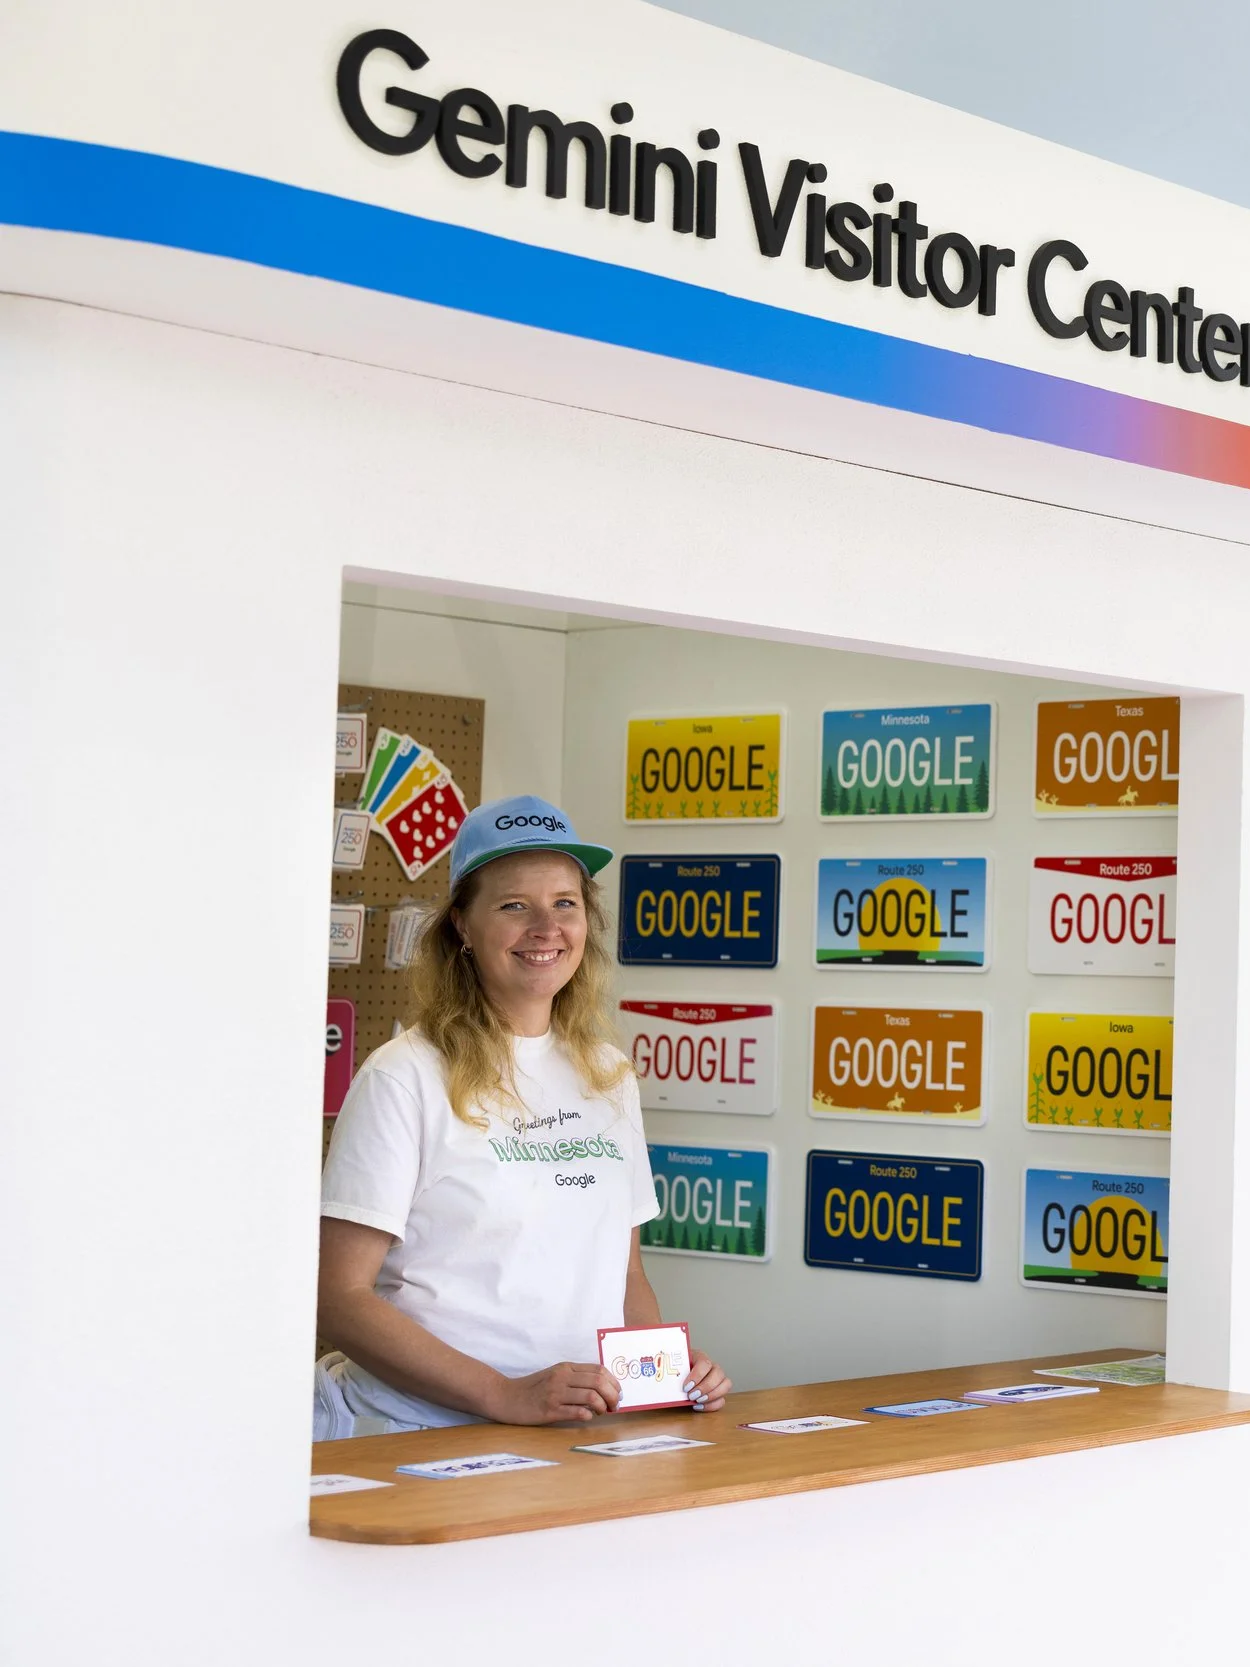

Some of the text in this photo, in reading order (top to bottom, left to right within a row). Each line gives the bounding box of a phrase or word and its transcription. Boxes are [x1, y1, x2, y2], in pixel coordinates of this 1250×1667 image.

[336, 28, 720, 240] Gemini
[738, 141, 1015, 316] Visitor
[881, 714, 930, 727] Minnesota
[1115, 705, 1144, 717] Texas
[692, 723, 713, 735] Iowa
[640, 744, 766, 794] GOOGLE
[837, 735, 975, 789] GOOGLE
[1053, 729, 1180, 784] GOOGL
[495, 815, 567, 833] Google
[677, 865, 720, 877] Route 250
[878, 864, 924, 876] Route 250
[1100, 863, 1152, 875] Route 250
[636, 890, 762, 938] GOOGLE
[833, 888, 970, 938] GOOGLE
[1050, 892, 1176, 945] GOOGL
[672, 1007, 716, 1020] Route 250
[884, 1014, 910, 1027] Texas
[1109, 1021, 1134, 1034] Iowa
[632, 1033, 757, 1085] GOOGLE
[828, 1036, 967, 1092] GOOGLE
[1046, 1045, 1172, 1101] GOOGL
[512, 1108, 581, 1134] Greetings from
[488, 1133, 624, 1162] Minnesota
[667, 1151, 713, 1166] Minnesota
[554, 1173, 596, 1189] Google
[870, 1165, 917, 1179] Route 250
[1092, 1180, 1144, 1194] Route 250
[653, 1174, 753, 1228] OOGLE
[824, 1188, 963, 1247] GOOGLE
[1042, 1202, 1168, 1263] GOOGL
